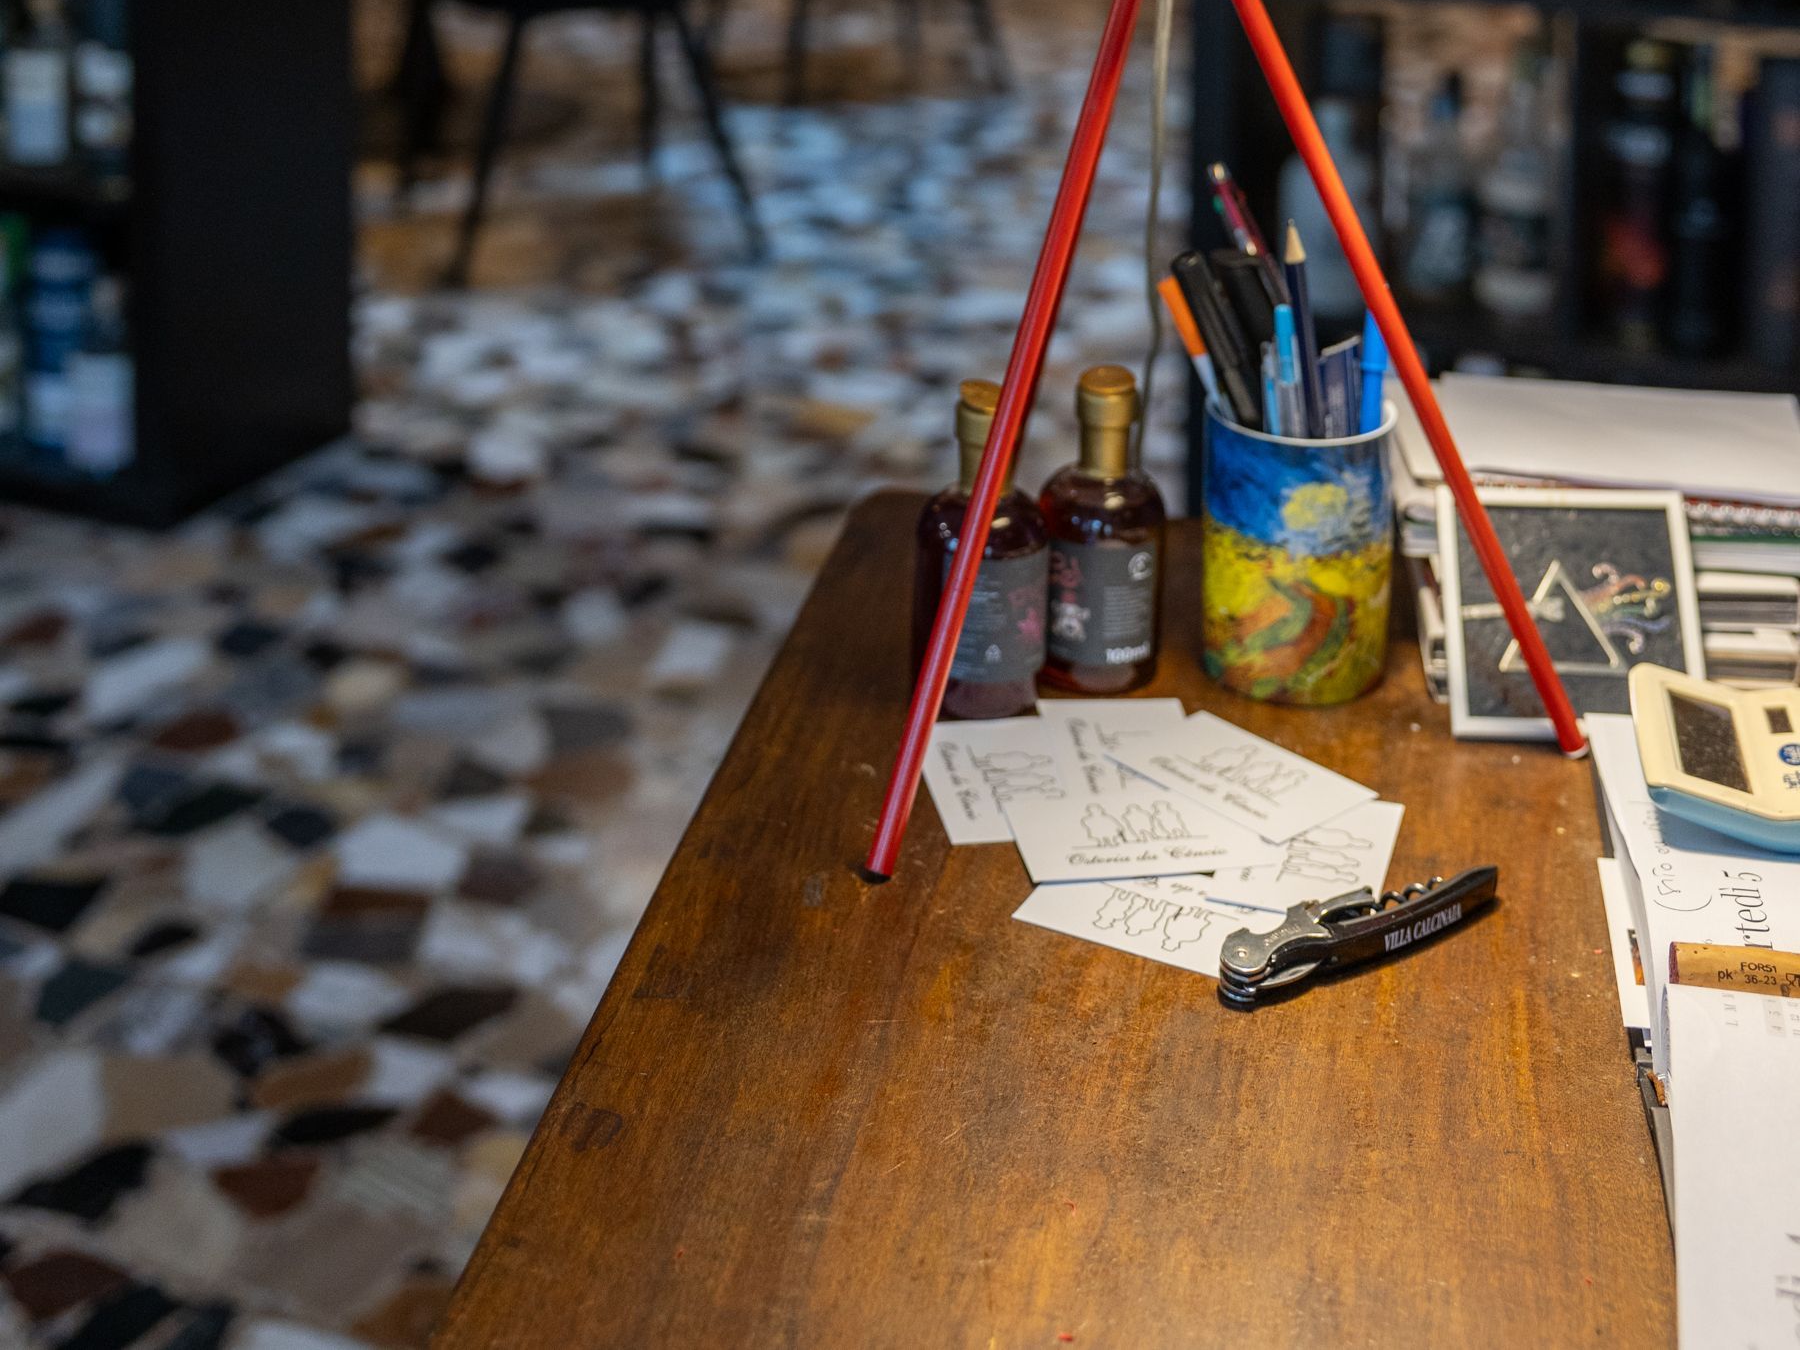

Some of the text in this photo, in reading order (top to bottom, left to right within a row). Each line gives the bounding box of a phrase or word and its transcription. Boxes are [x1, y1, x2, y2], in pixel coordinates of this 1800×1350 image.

[1718, 887, 1774, 951] rtedì
[1384, 925, 1413, 952] VILLA
[1744, 973, 1777, 986] 36-23
